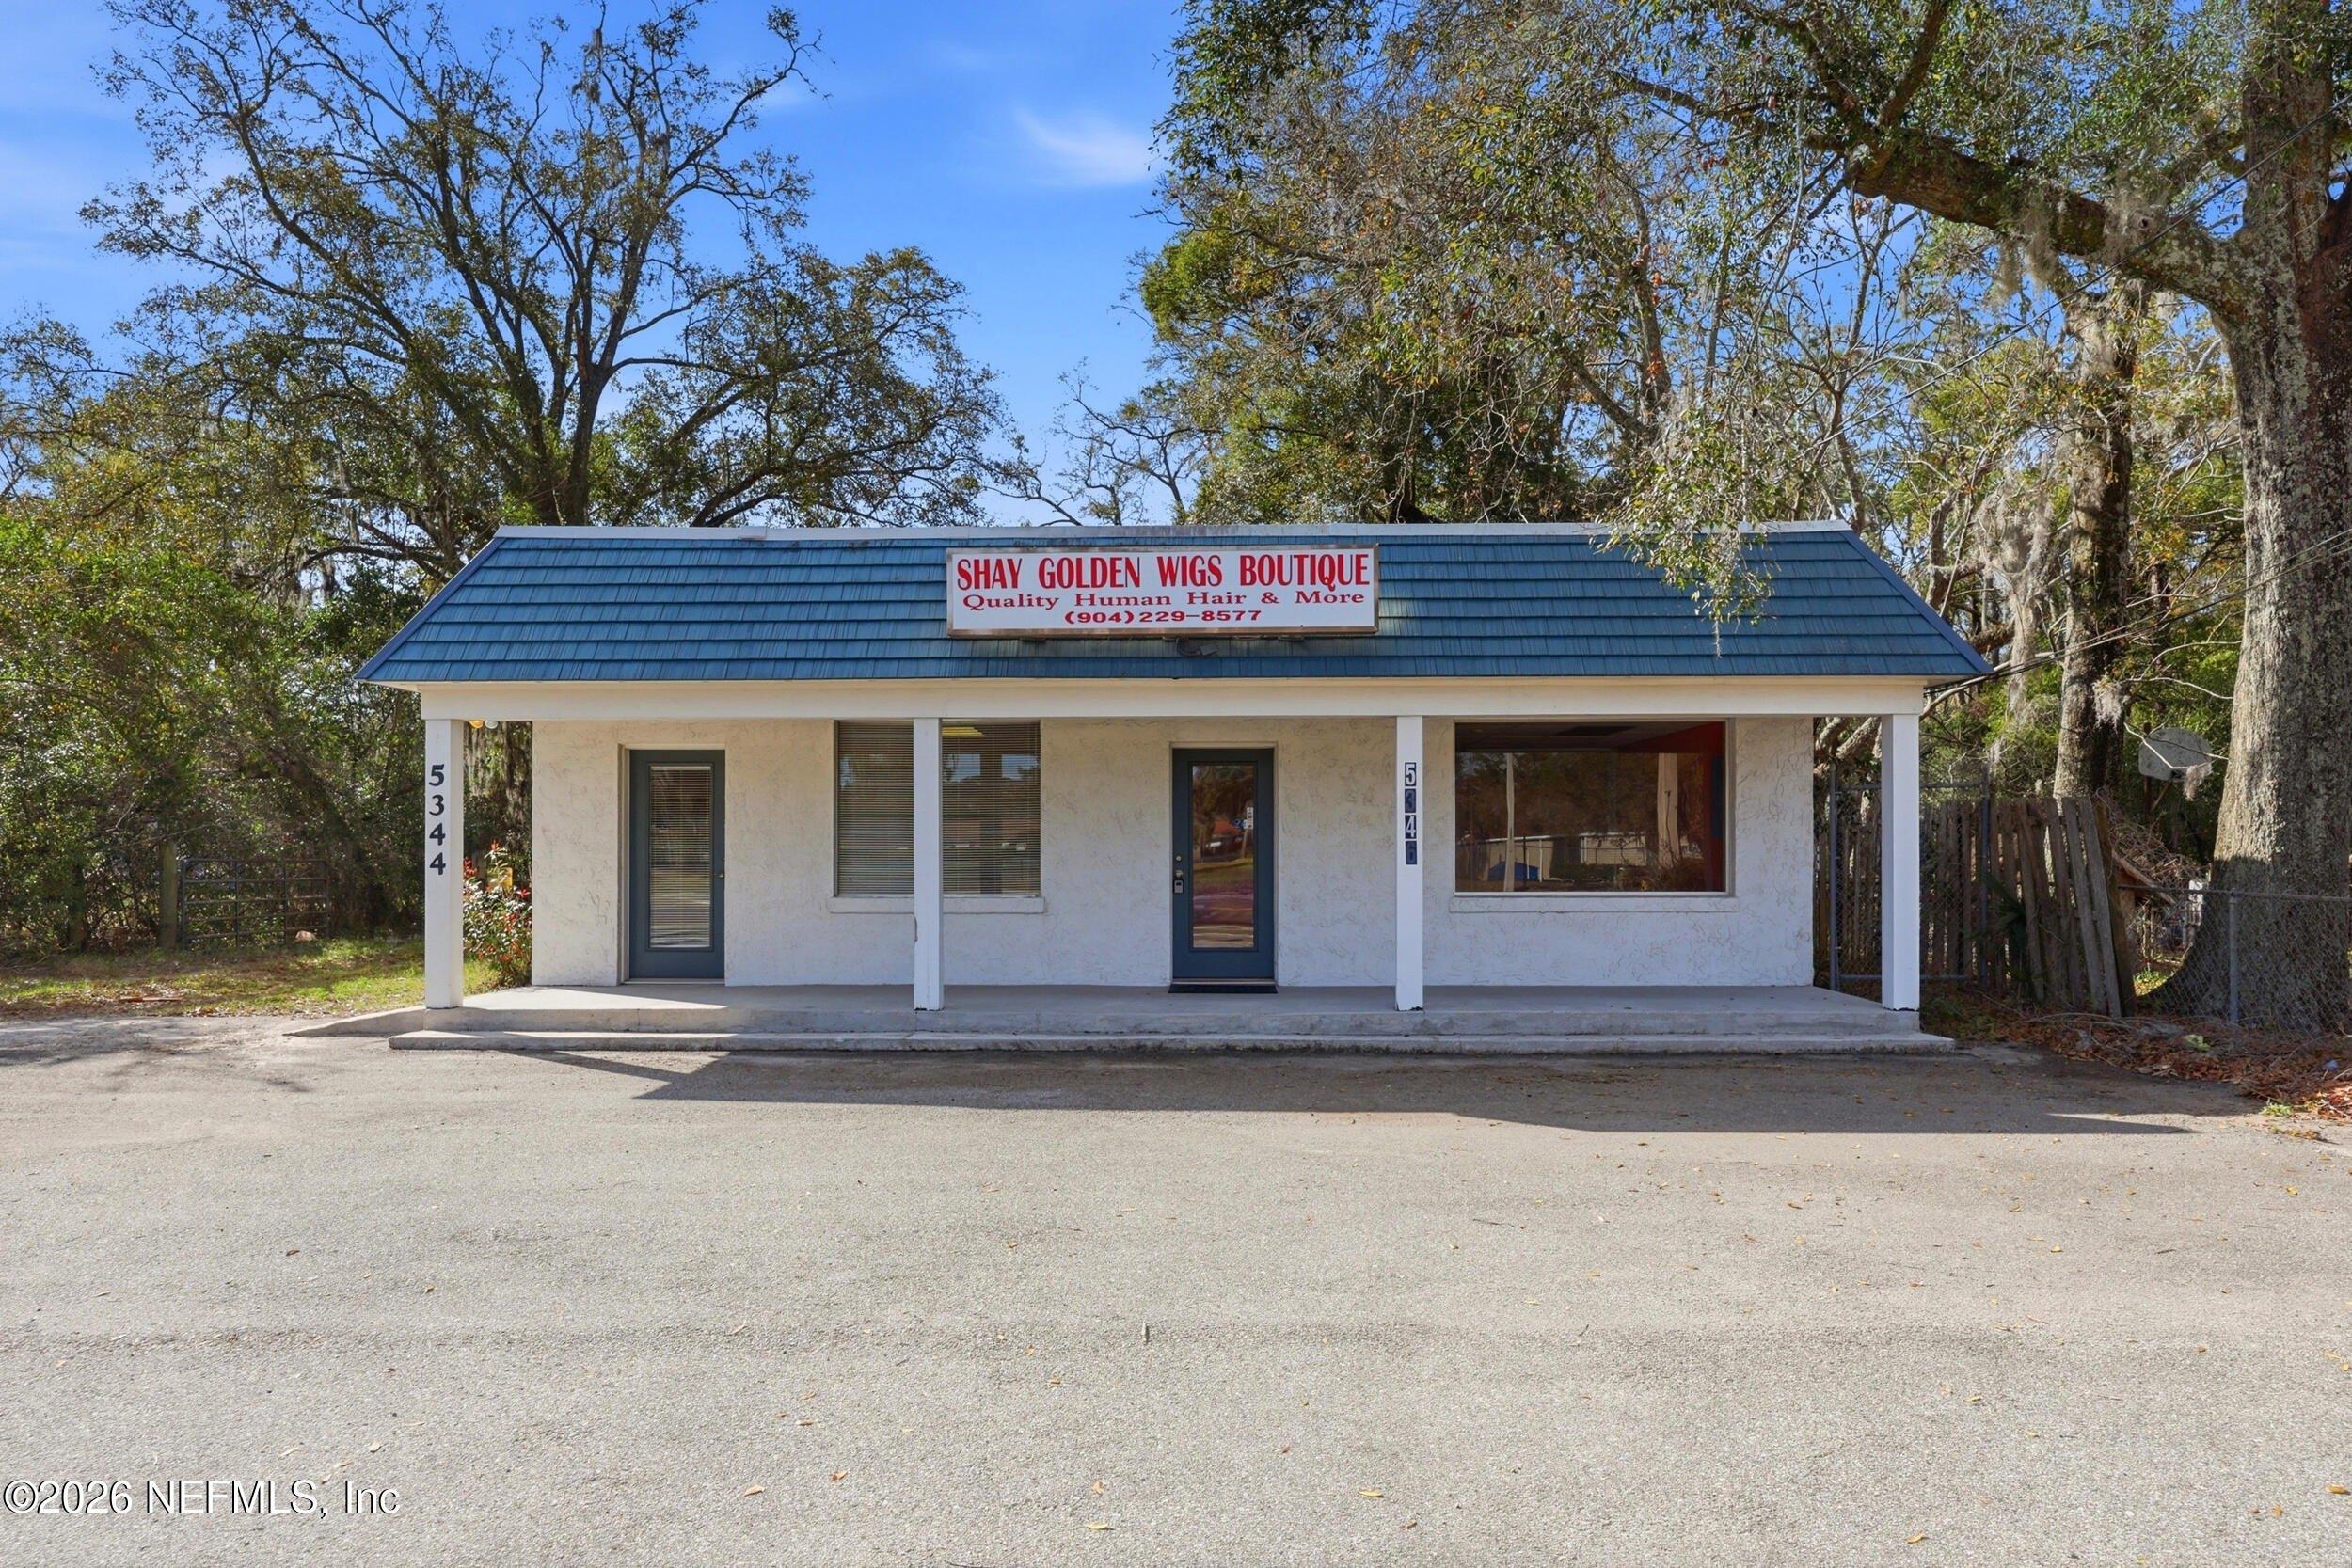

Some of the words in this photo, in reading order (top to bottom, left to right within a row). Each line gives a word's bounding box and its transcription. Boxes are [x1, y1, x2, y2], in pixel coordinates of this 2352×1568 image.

[957, 558, 1023, 591] SHAY
[1038, 556, 1140, 589] GOLDEN
[1156, 555, 1223, 587] WIGS
[1240, 553, 1370, 592] BOUTIQUE
[962, 594, 1059, 610] Quality
[1074, 593, 1171, 607] Human
[1187, 591, 1247, 604] Hair
[1261, 592, 1280, 604] &
[1295, 590, 1364, 604] More
[1064, 610, 1262, 624] (904)229-8577
[428, 763, 446, 876] 5344
